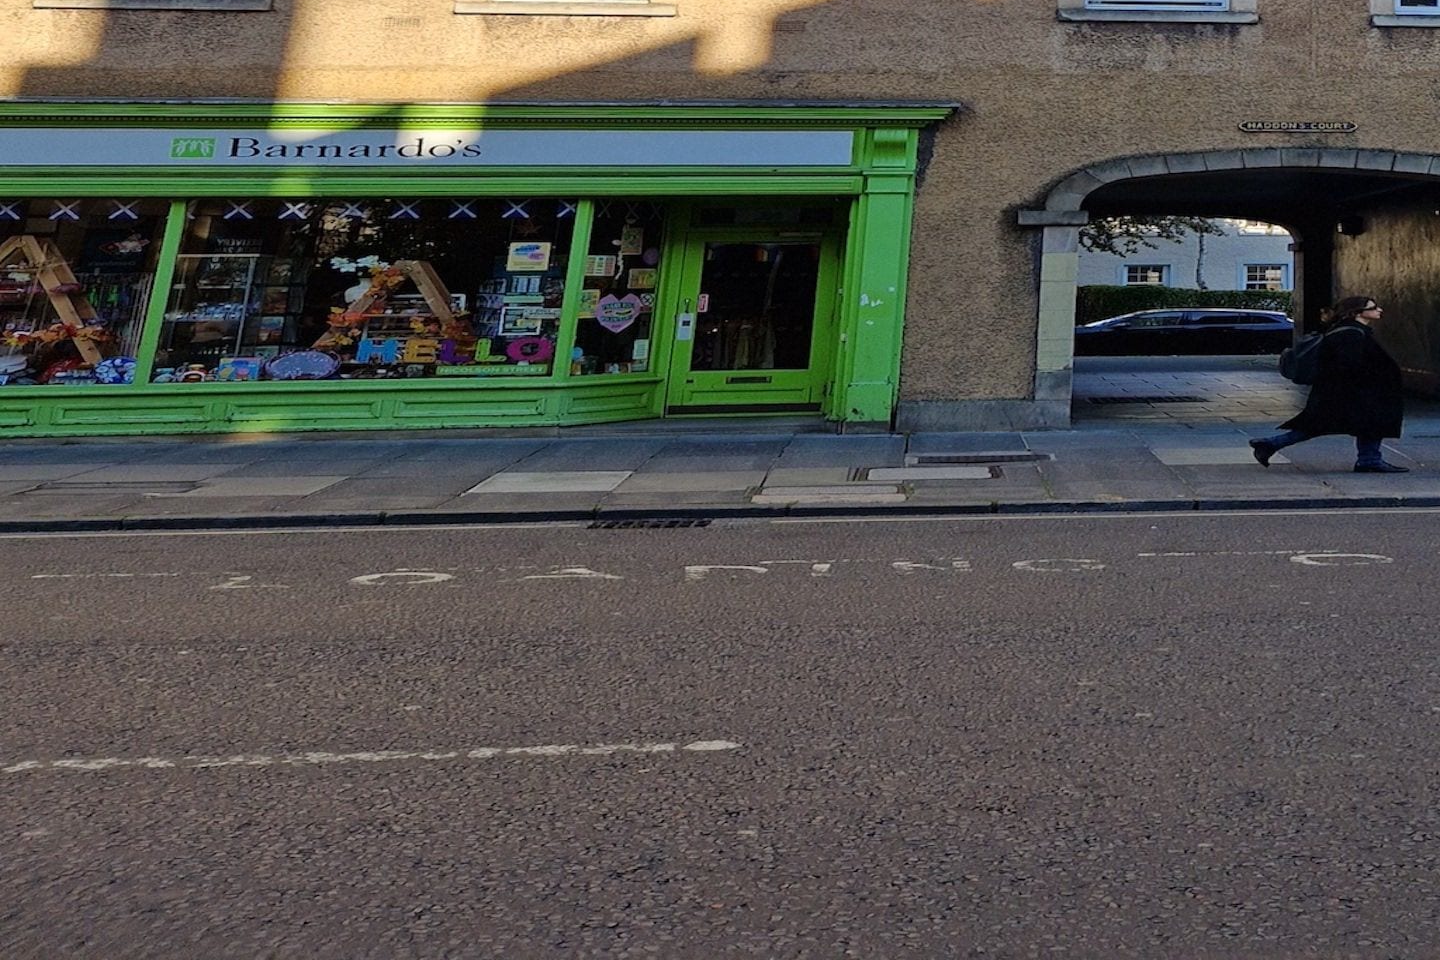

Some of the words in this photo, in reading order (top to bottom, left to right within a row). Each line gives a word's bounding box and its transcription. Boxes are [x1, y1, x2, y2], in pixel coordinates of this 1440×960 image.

[1310, 121, 1351, 130] COURT
[228, 137, 482, 159] Barnardo's
[356, 337, 555, 365] HELLO
